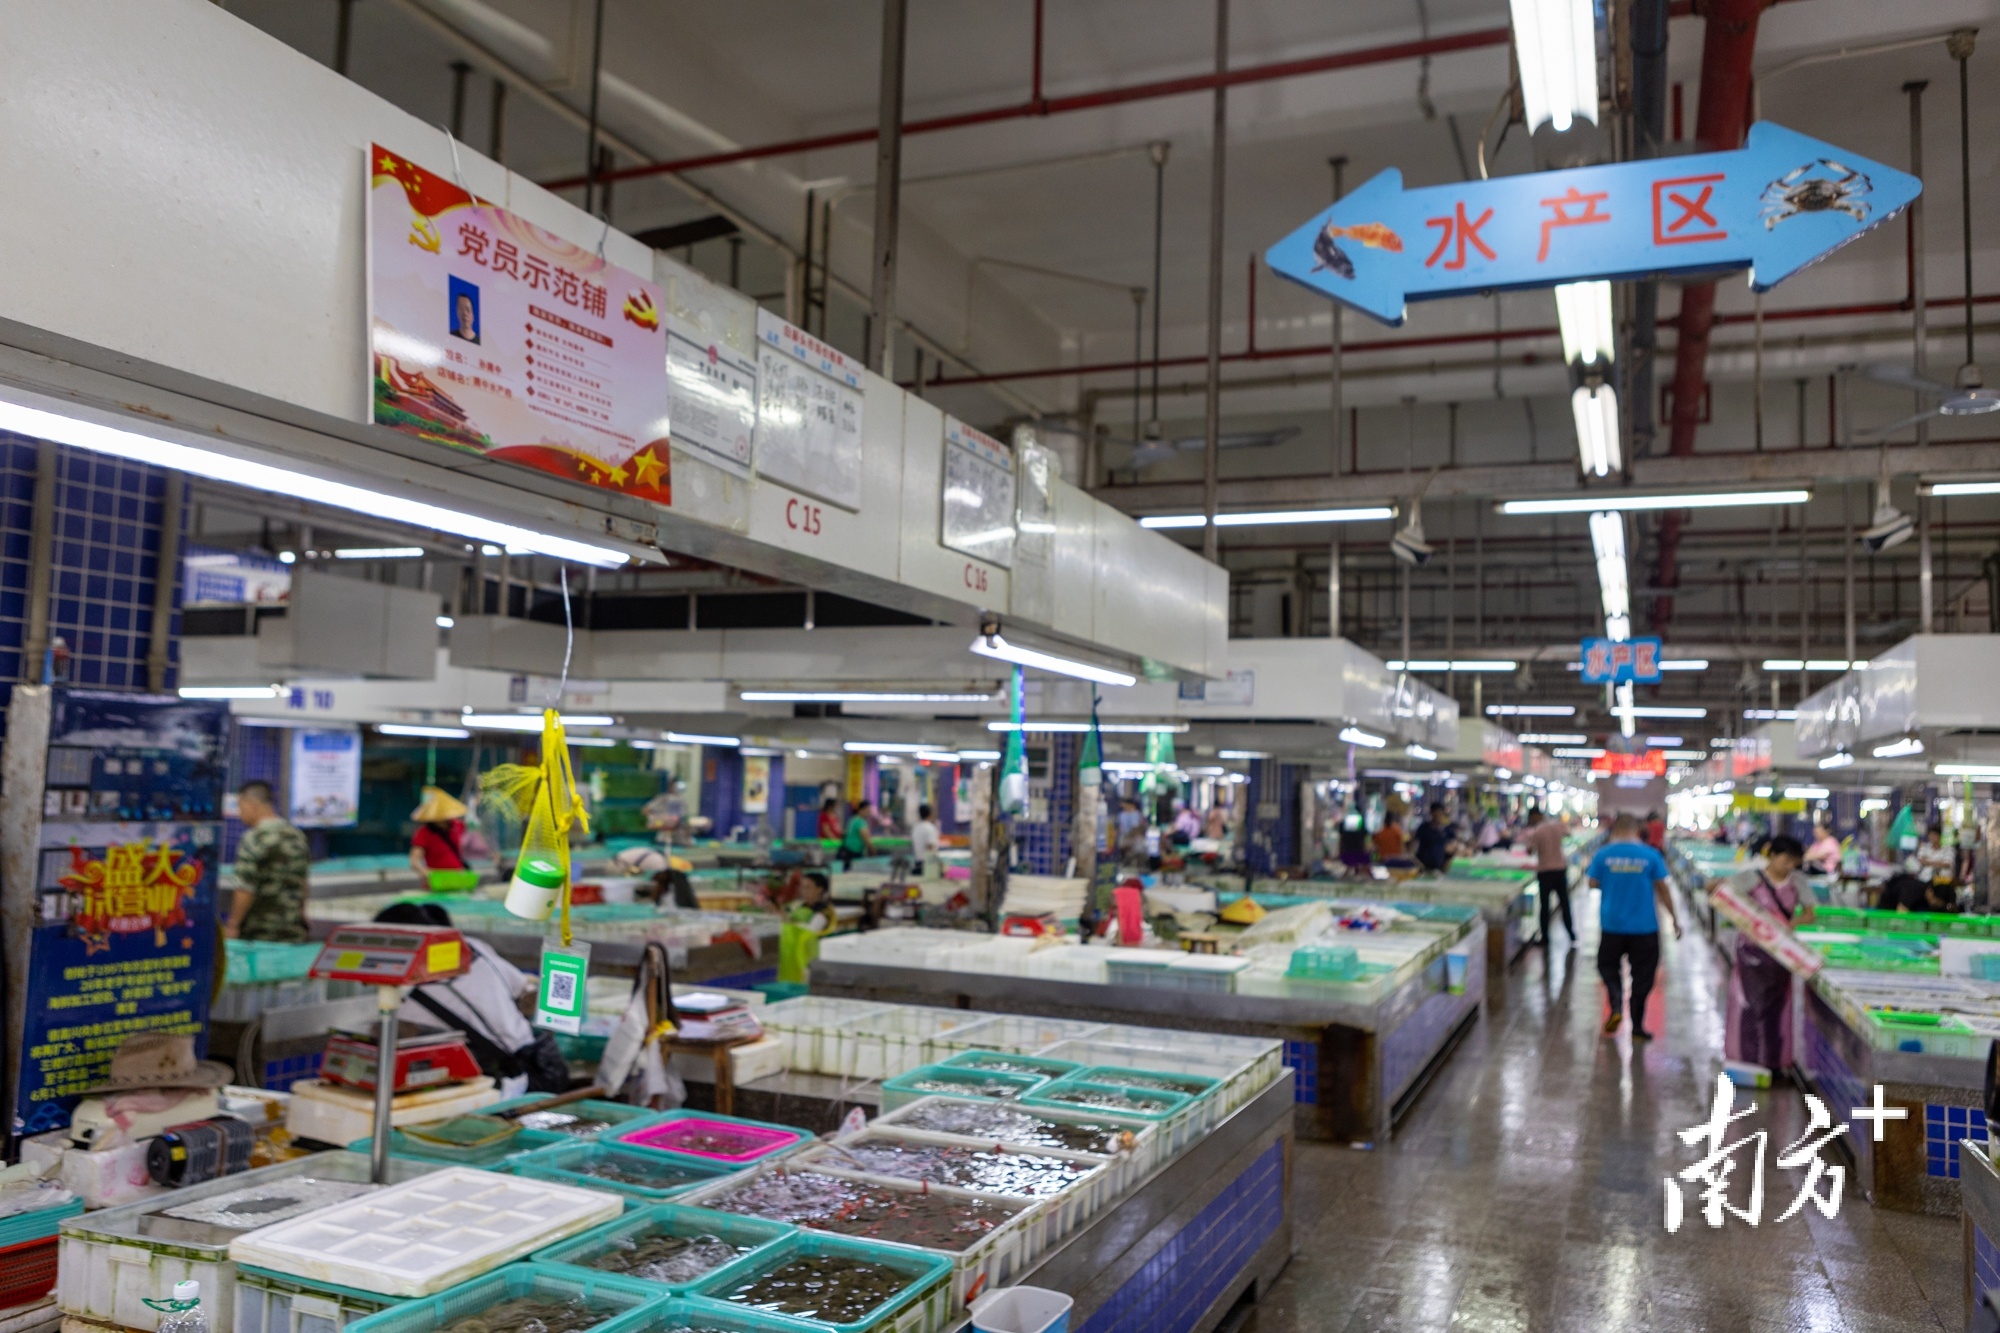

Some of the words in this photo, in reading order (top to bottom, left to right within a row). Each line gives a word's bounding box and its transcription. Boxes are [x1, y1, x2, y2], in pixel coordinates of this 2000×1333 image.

[1424, 172, 1728, 271] 水产区
[457, 222, 608, 320] 党员示范铺
[786, 498, 798, 530] C
[803, 505, 822, 536] 15
[963, 563, 973, 589] C
[975, 567, 989, 593] 16
[1585, 642, 1659, 681] 水产区
[103, 842, 197, 888] 盛大
